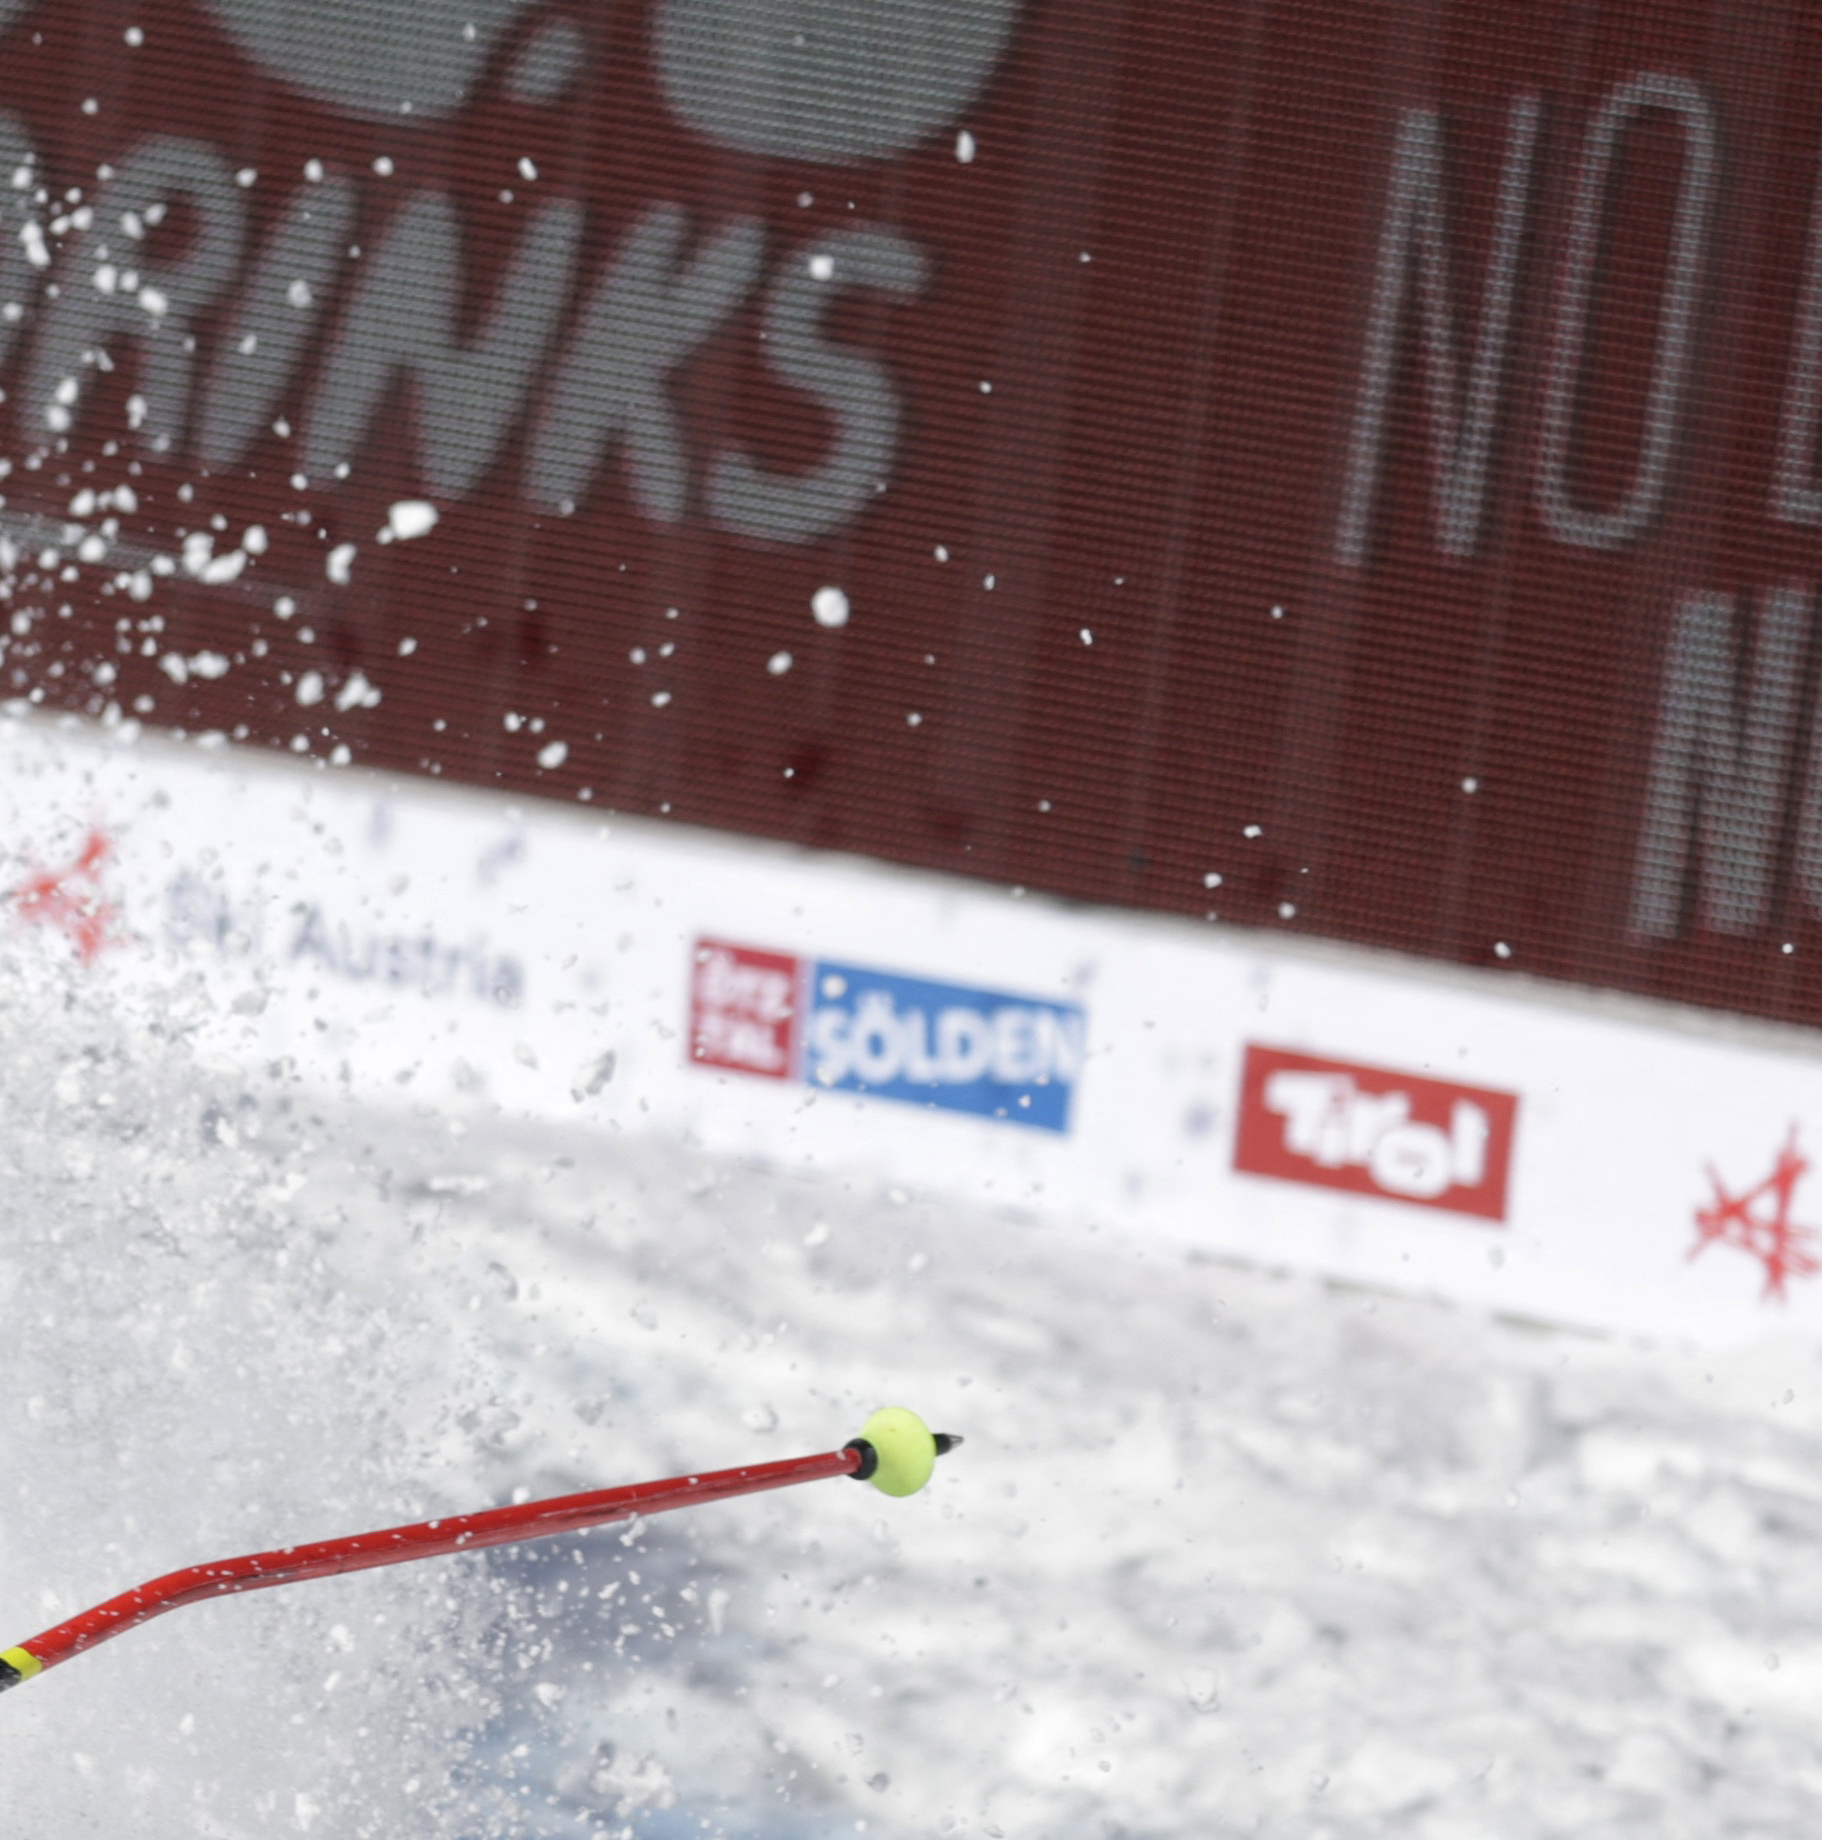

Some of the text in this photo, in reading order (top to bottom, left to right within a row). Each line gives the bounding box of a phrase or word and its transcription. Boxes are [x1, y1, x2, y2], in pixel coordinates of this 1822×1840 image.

[1333, 72, 1718, 567] NO
[808, 990, 1086, 1086] SÖLDEN
[1264, 1069, 1489, 1200] Tirol
